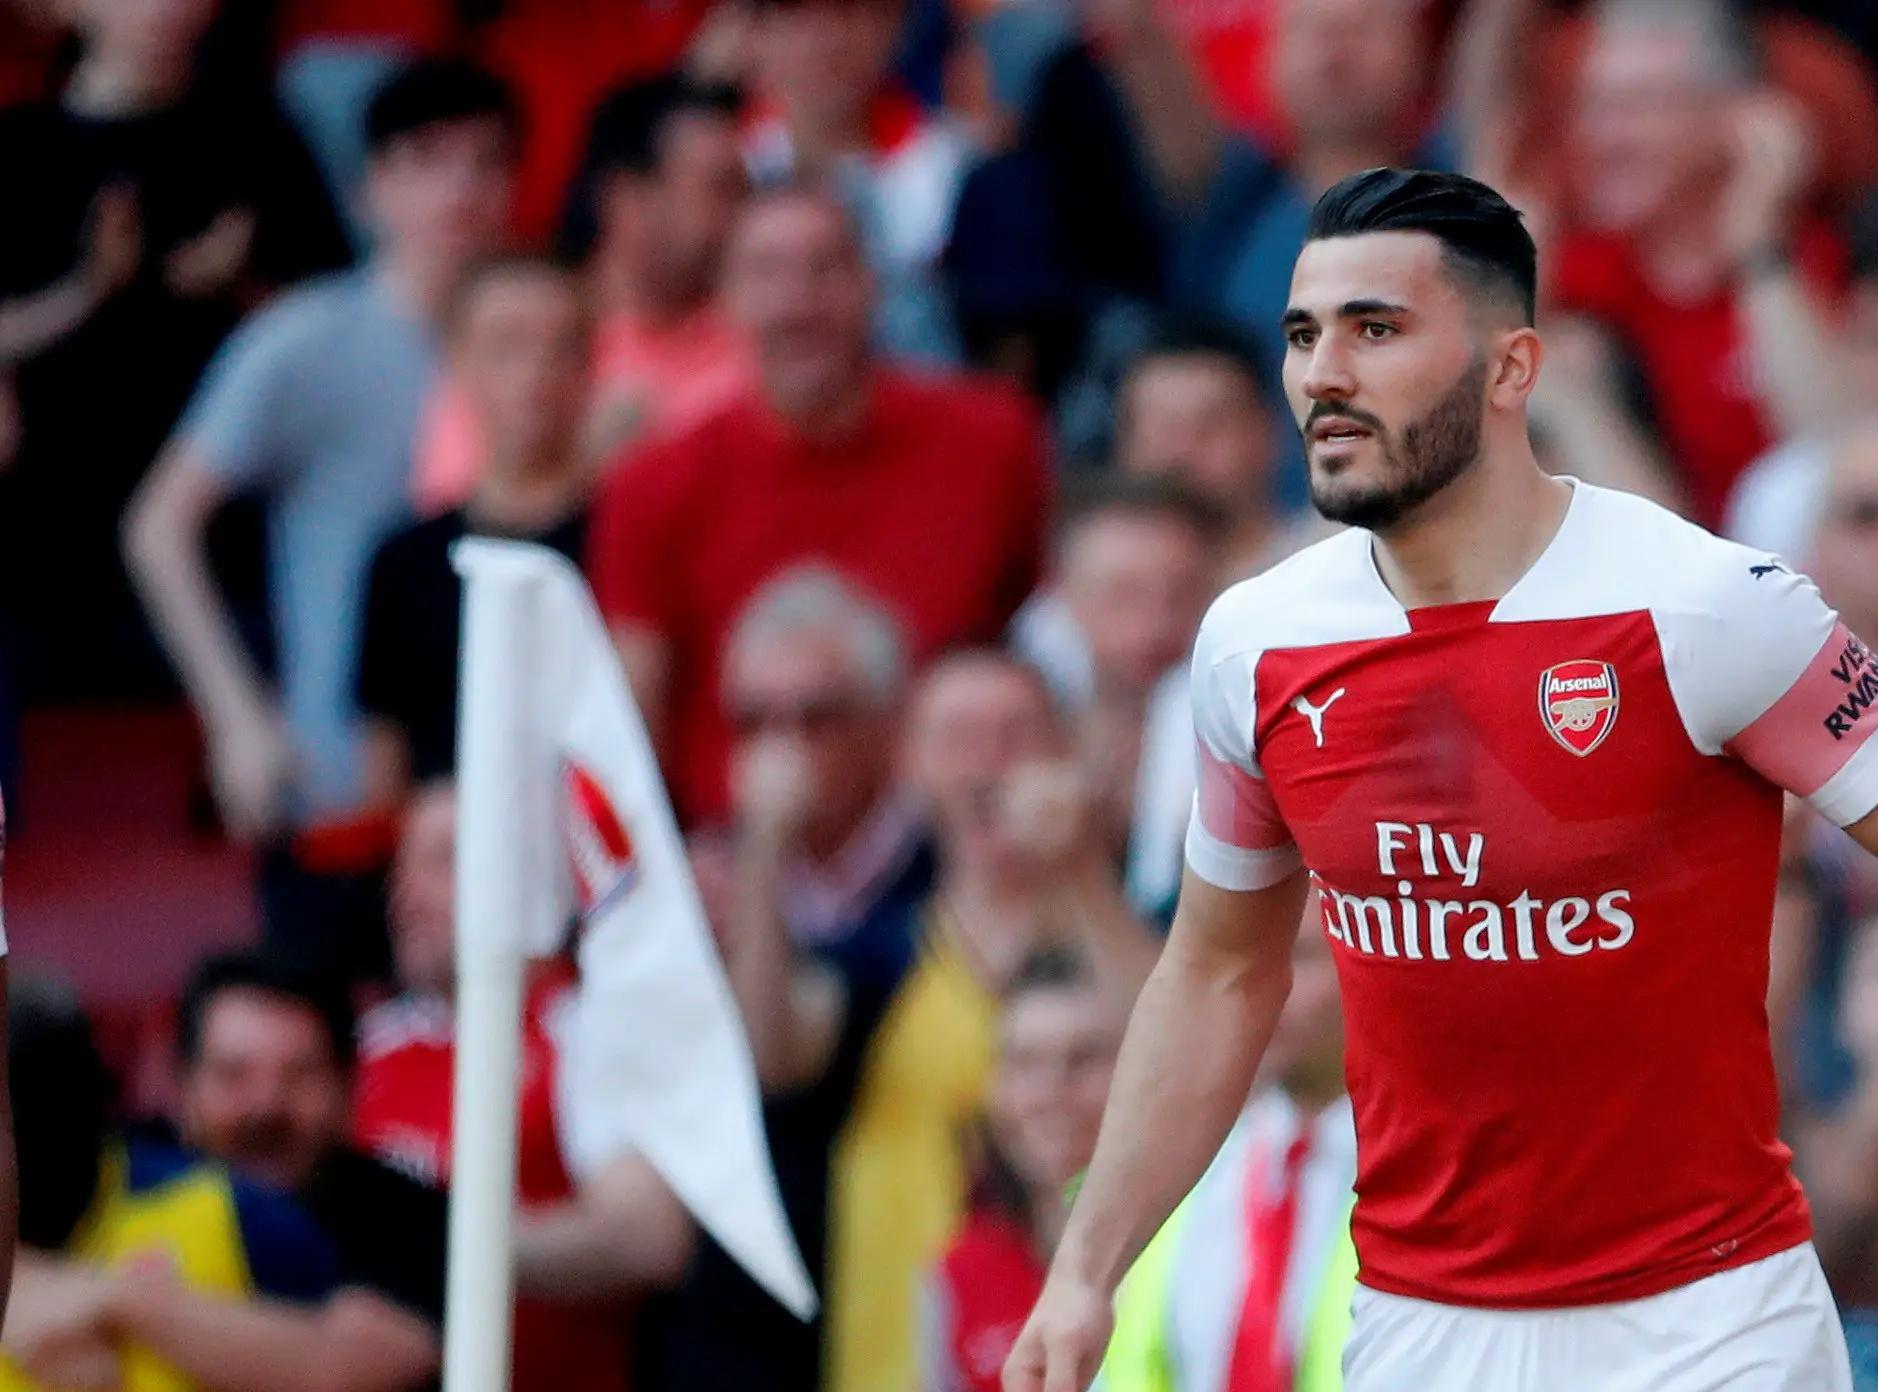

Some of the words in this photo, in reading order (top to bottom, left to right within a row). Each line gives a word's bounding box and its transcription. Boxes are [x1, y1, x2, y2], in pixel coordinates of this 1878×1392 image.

[1548, 673, 1608, 694] Arsenal
[1830, 639, 1866, 684] VIS
[1375, 821, 1485, 888] Fly
